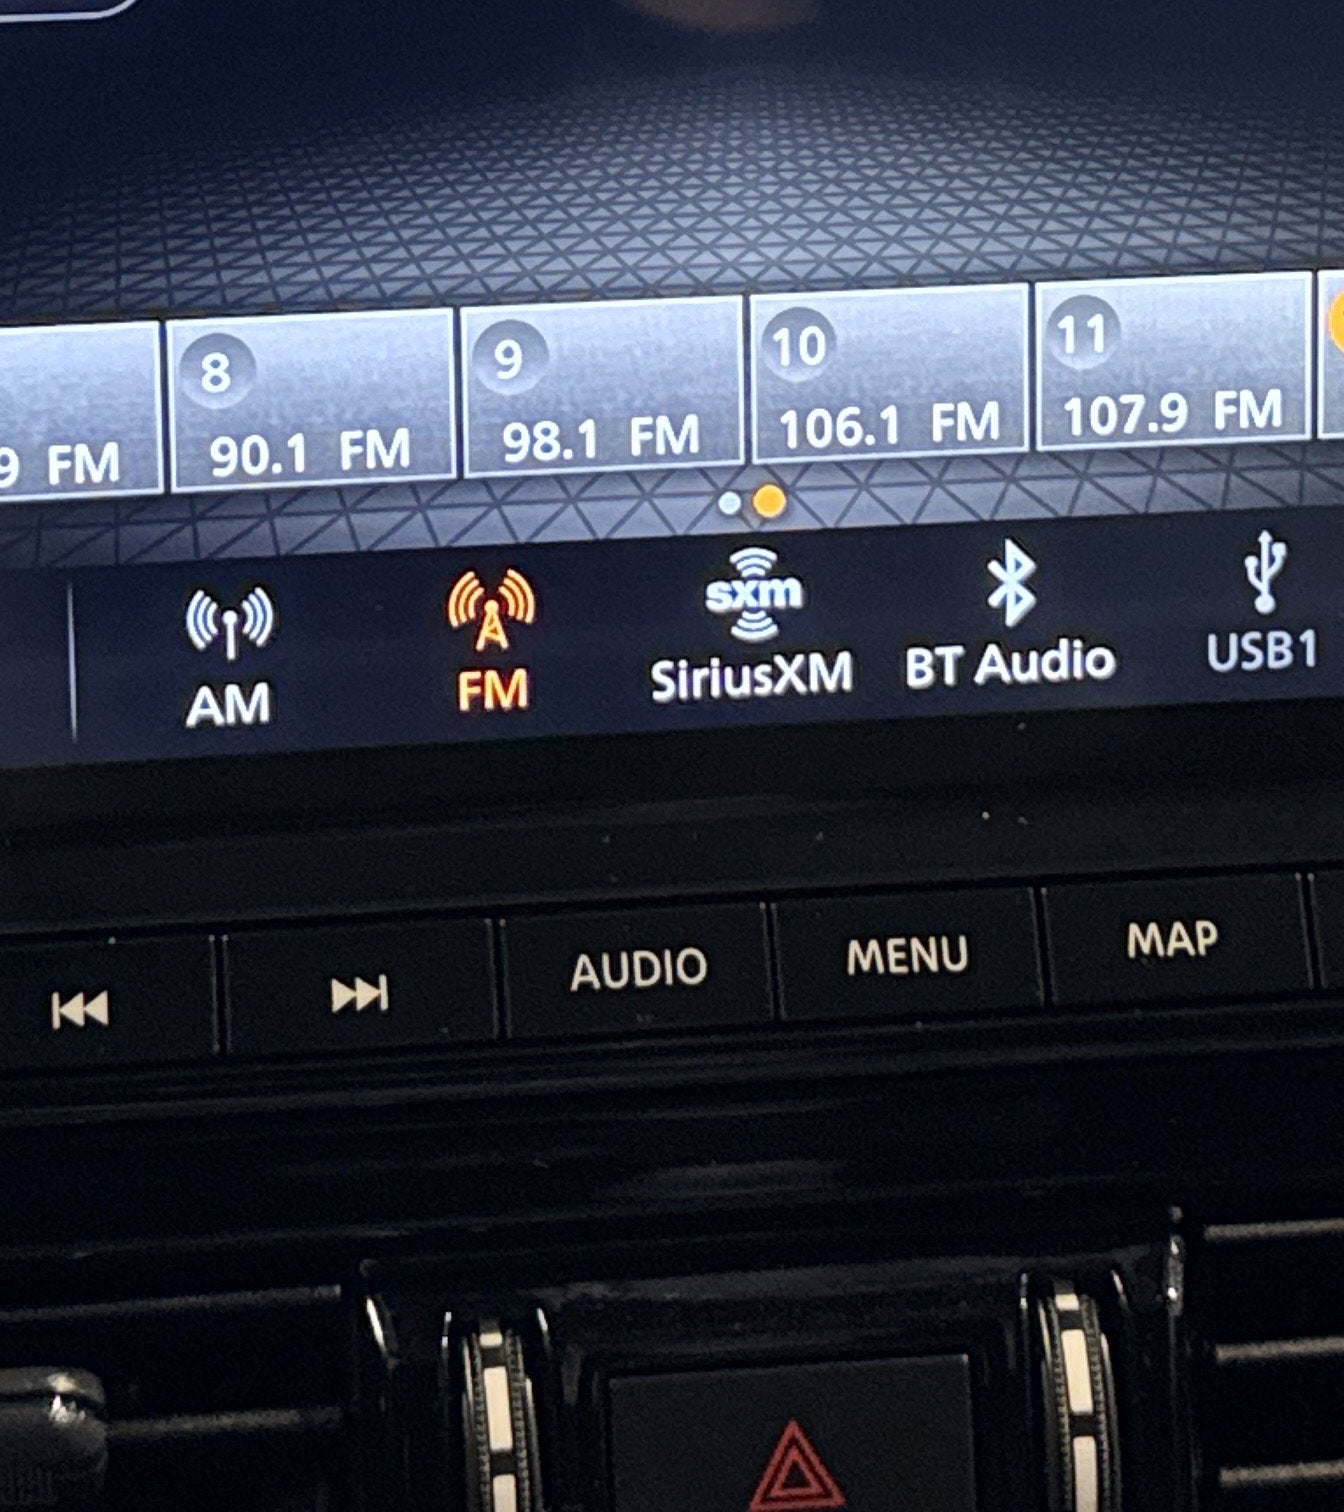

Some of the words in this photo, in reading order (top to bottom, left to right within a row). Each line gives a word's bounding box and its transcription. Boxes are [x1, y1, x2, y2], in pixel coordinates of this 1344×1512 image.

[771, 322, 828, 368] 10
[1056, 311, 1107, 355] 11
[201, 352, 231, 393] 8
[494, 339, 522, 380] 9
[779, 404, 898, 450] 106.1
[932, 400, 1000, 443] FM
[1064, 392, 1188, 436] 107.9
[1214, 388, 1283, 431] FM
[210, 432, 305, 478] 90.1
[340, 427, 410, 471] FM
[503, 418, 596, 463] 98.1
[630, 413, 700, 457] FM
[48, 441, 120, 486] FM
[706, 573, 803, 611] sxm
[906, 645, 965, 689] BT
[973, 638, 1116, 685] Audio
[1208, 629, 1315, 672] USB1
[458, 668, 528, 712] FM
[651, 650, 853, 702] SiriusXM
[186, 682, 270, 727] AM
[847, 935, 968, 975] MENU
[1127, 920, 1218, 958] MAP
[570, 947, 707, 991] AUDIO
